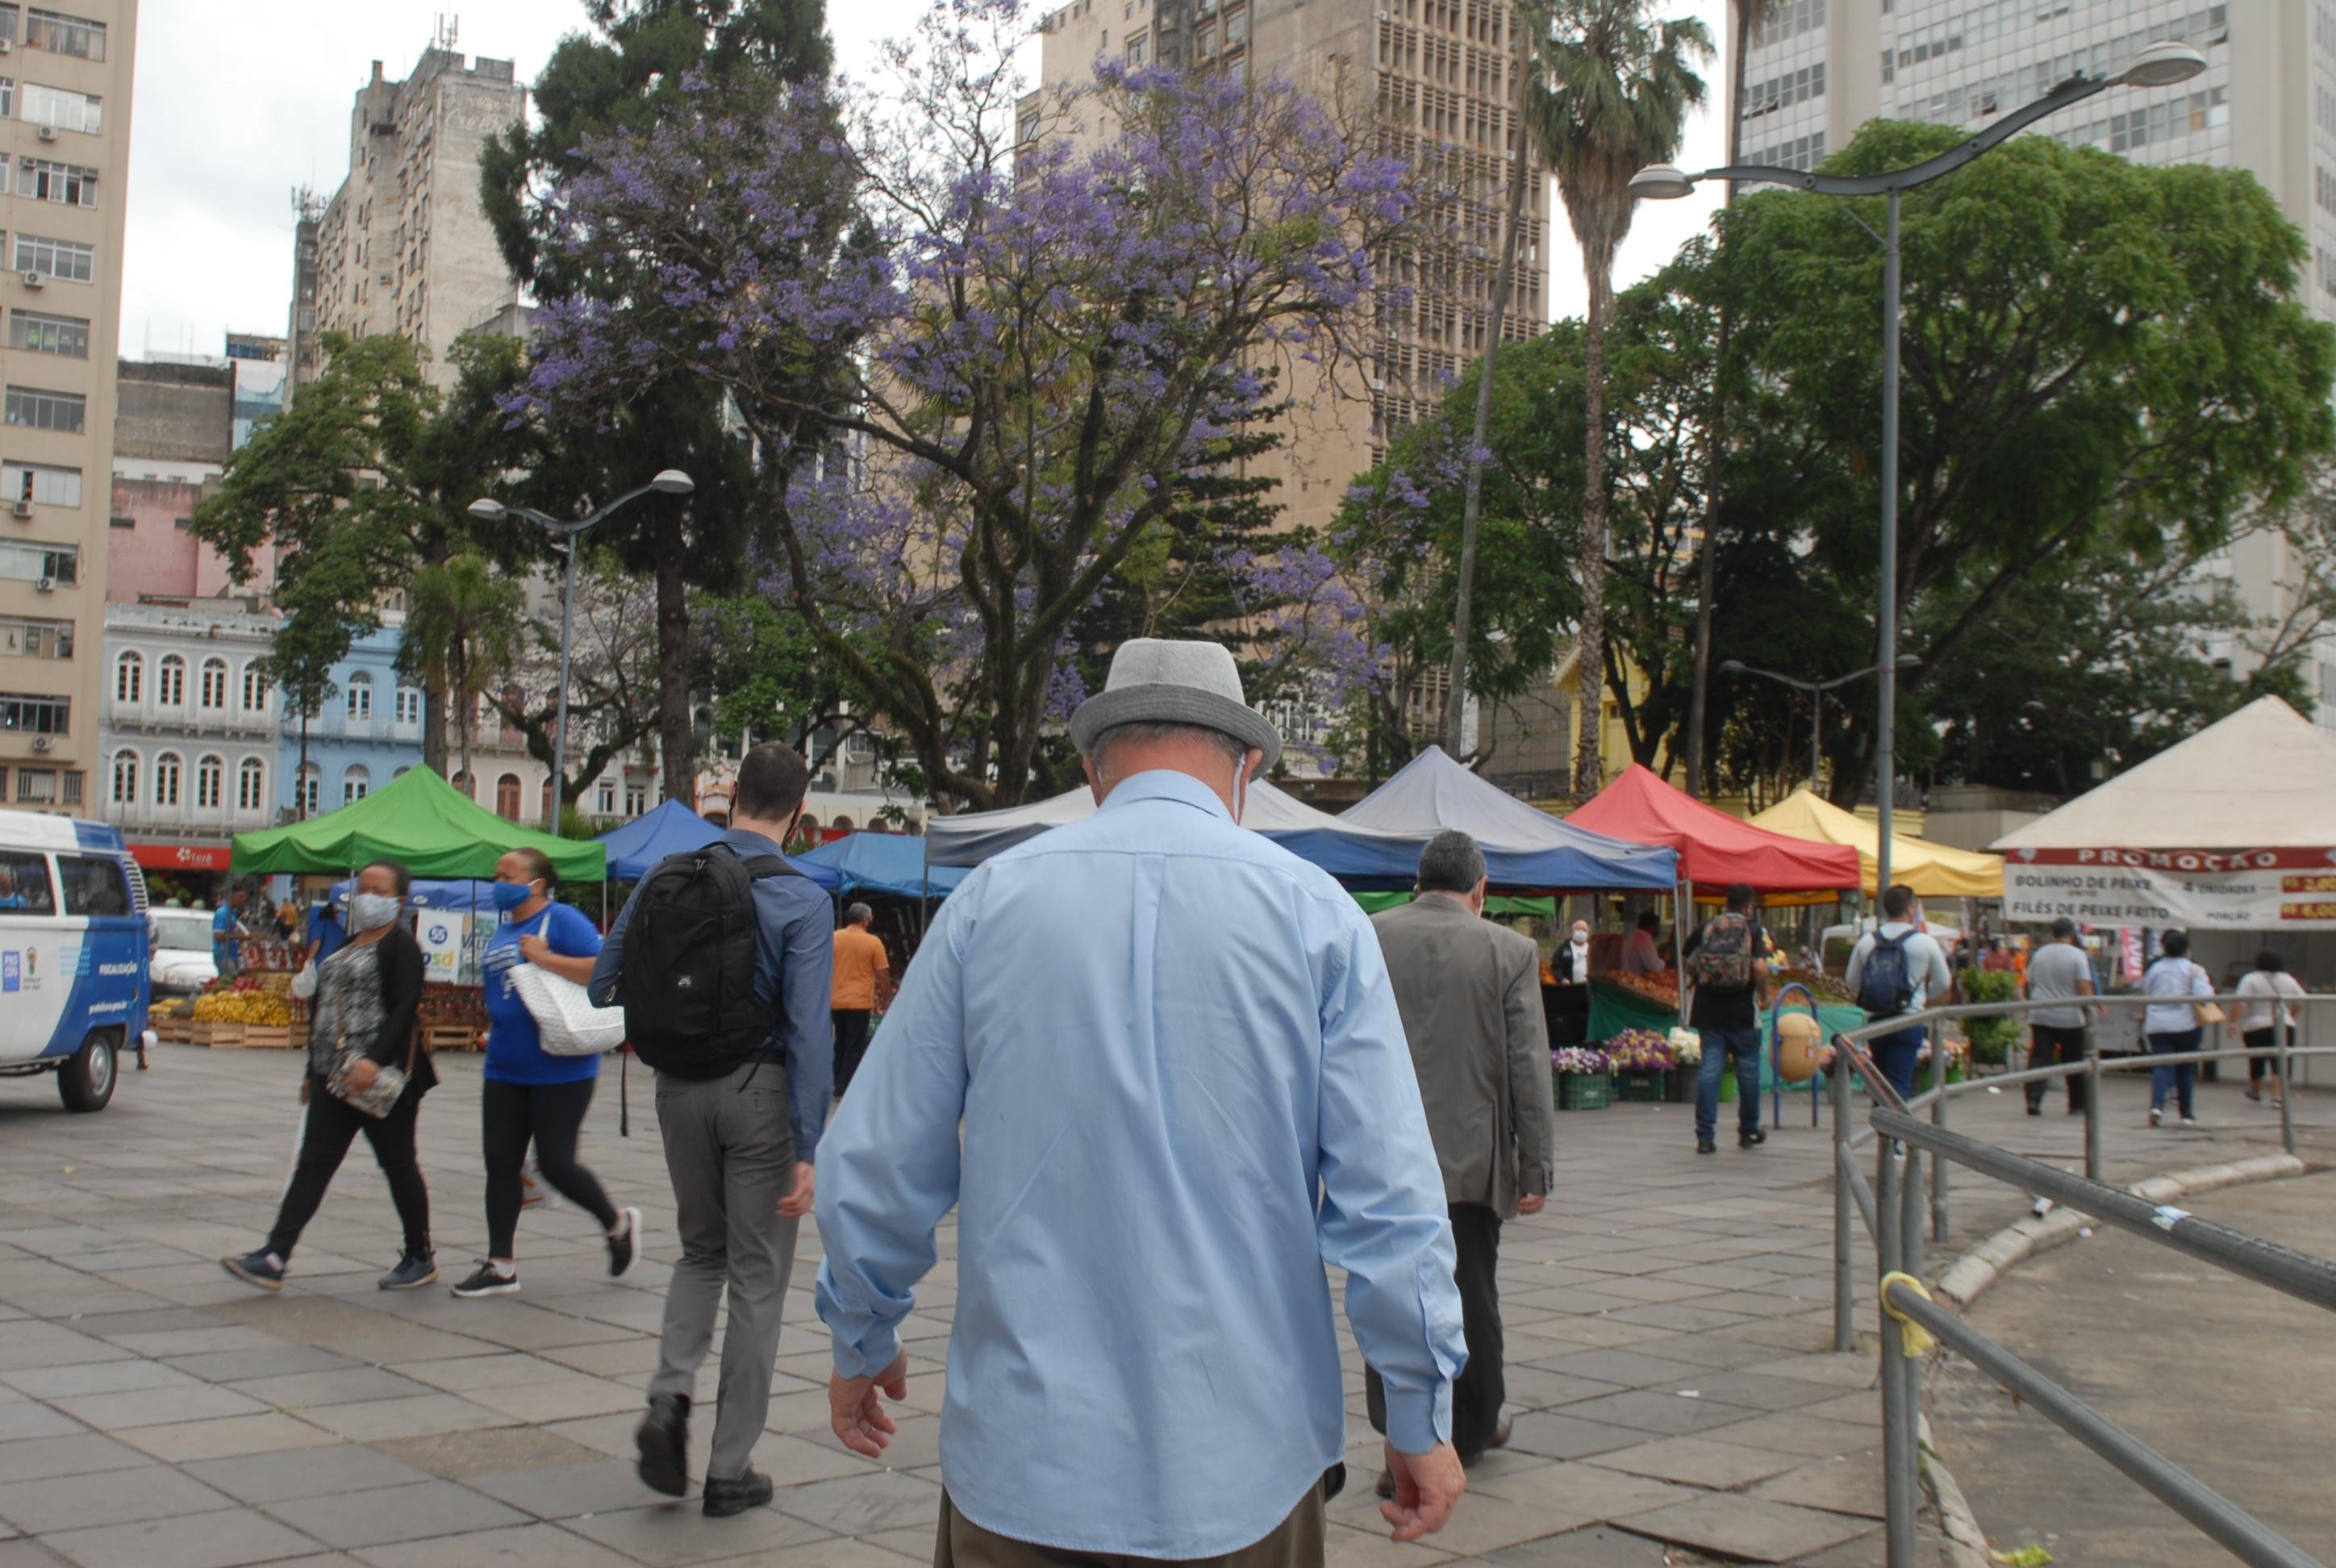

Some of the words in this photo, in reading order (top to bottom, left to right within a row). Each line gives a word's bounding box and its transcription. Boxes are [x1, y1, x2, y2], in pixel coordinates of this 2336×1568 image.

[2015, 876, 2083, 889] BOLINHO
[2085, 877, 2108, 889] DE
[2110, 878, 2152, 890] PEIXE
[2013, 899, 2053, 914] FILÉS
[2056, 903, 2075, 915] DE
[2079, 904, 2121, 916] PEIXE
[2125, 906, 2170, 919] FRITO
[431, 928, 445, 942] 55
[476, 918, 495, 938] 55
